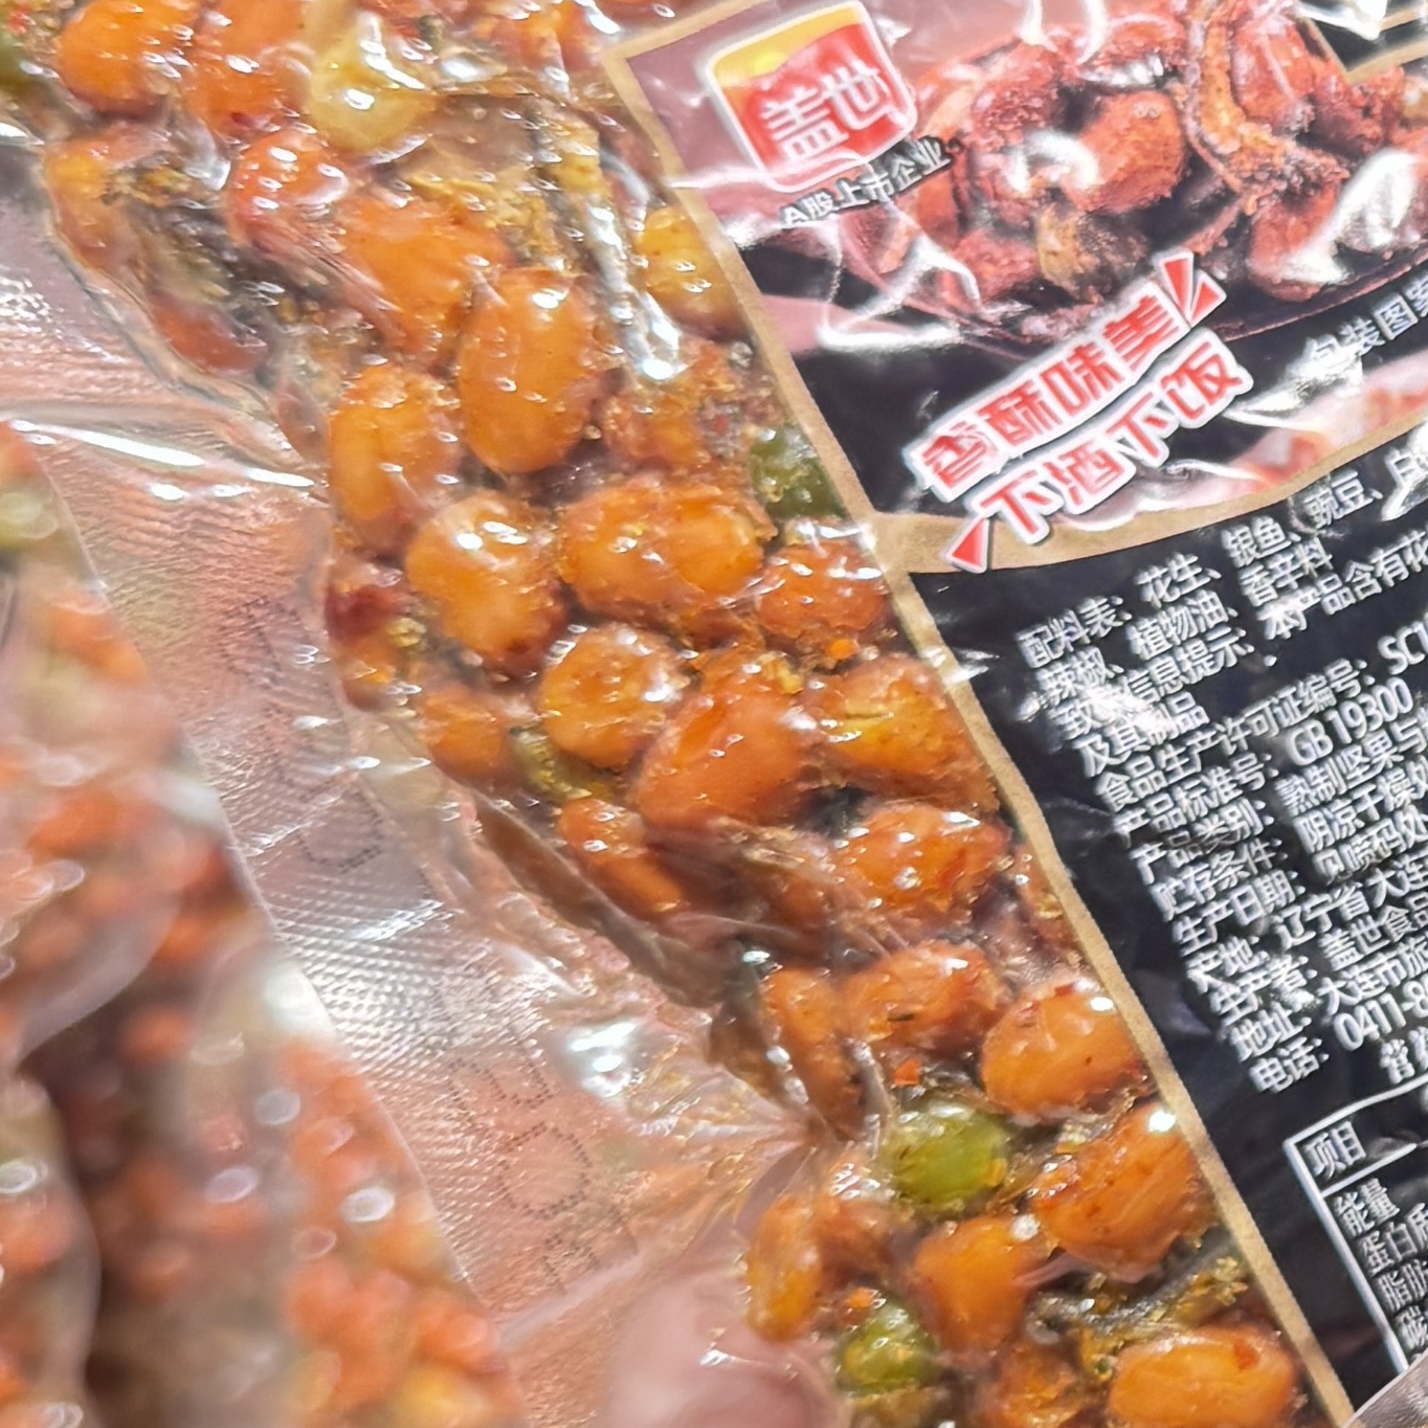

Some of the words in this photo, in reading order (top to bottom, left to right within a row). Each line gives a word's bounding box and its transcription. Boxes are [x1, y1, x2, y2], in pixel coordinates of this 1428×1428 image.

[760, 58, 892, 165] 盖世
[781, 136, 953, 225] A股上市企业
[918, 290, 1184, 490] 香酥味美
[975, 339, 1244, 539] 下酒下饭
[1327, 677, 1415, 747] 19300
[1303, 1120, 1367, 1181] 项目
